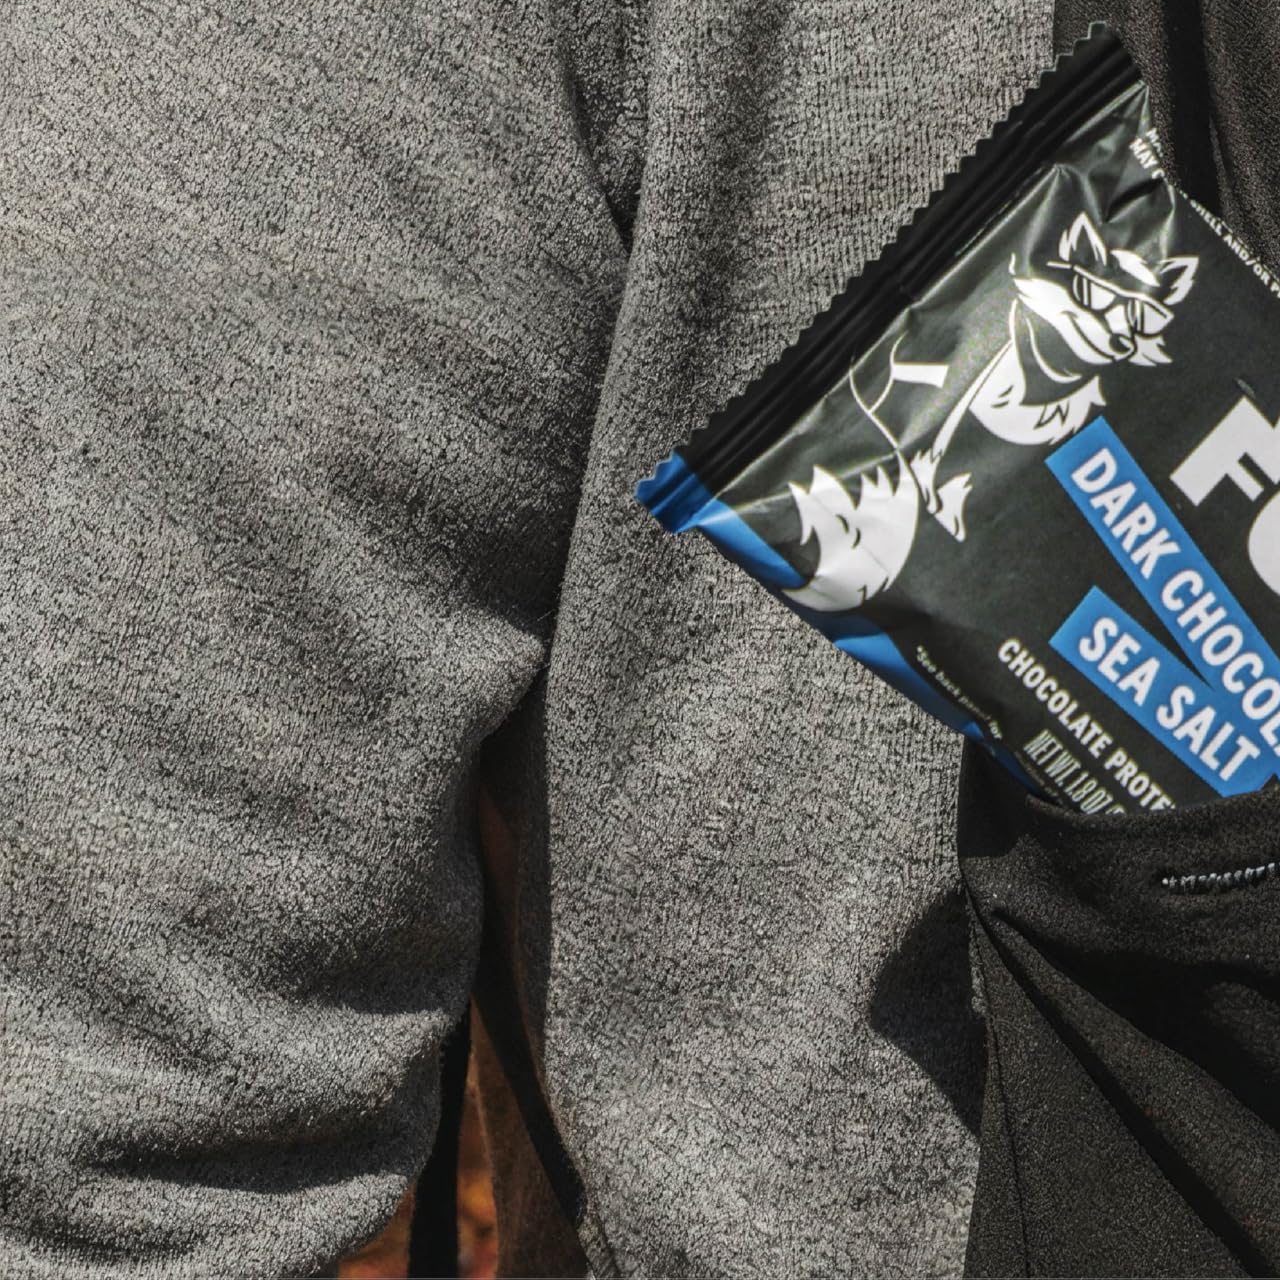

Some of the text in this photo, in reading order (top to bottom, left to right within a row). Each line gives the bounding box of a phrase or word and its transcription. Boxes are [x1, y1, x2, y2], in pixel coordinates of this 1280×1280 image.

[1129, 138, 1158, 169] MAY
[1223, 234, 1271, 286] AND/OR
[1071, 448, 1181, 580] DARK
[998, 637, 1113, 760] CHOCOLATE
[1103, 747, 1176, 810] PROTE
[1078, 616, 1162, 707] SEA
[1156, 694, 1261, 784] SALT
[1023, 729, 1063, 766] NET
[1045, 750, 1081, 787] WT.
[1064, 771, 1098, 803] 1.8
